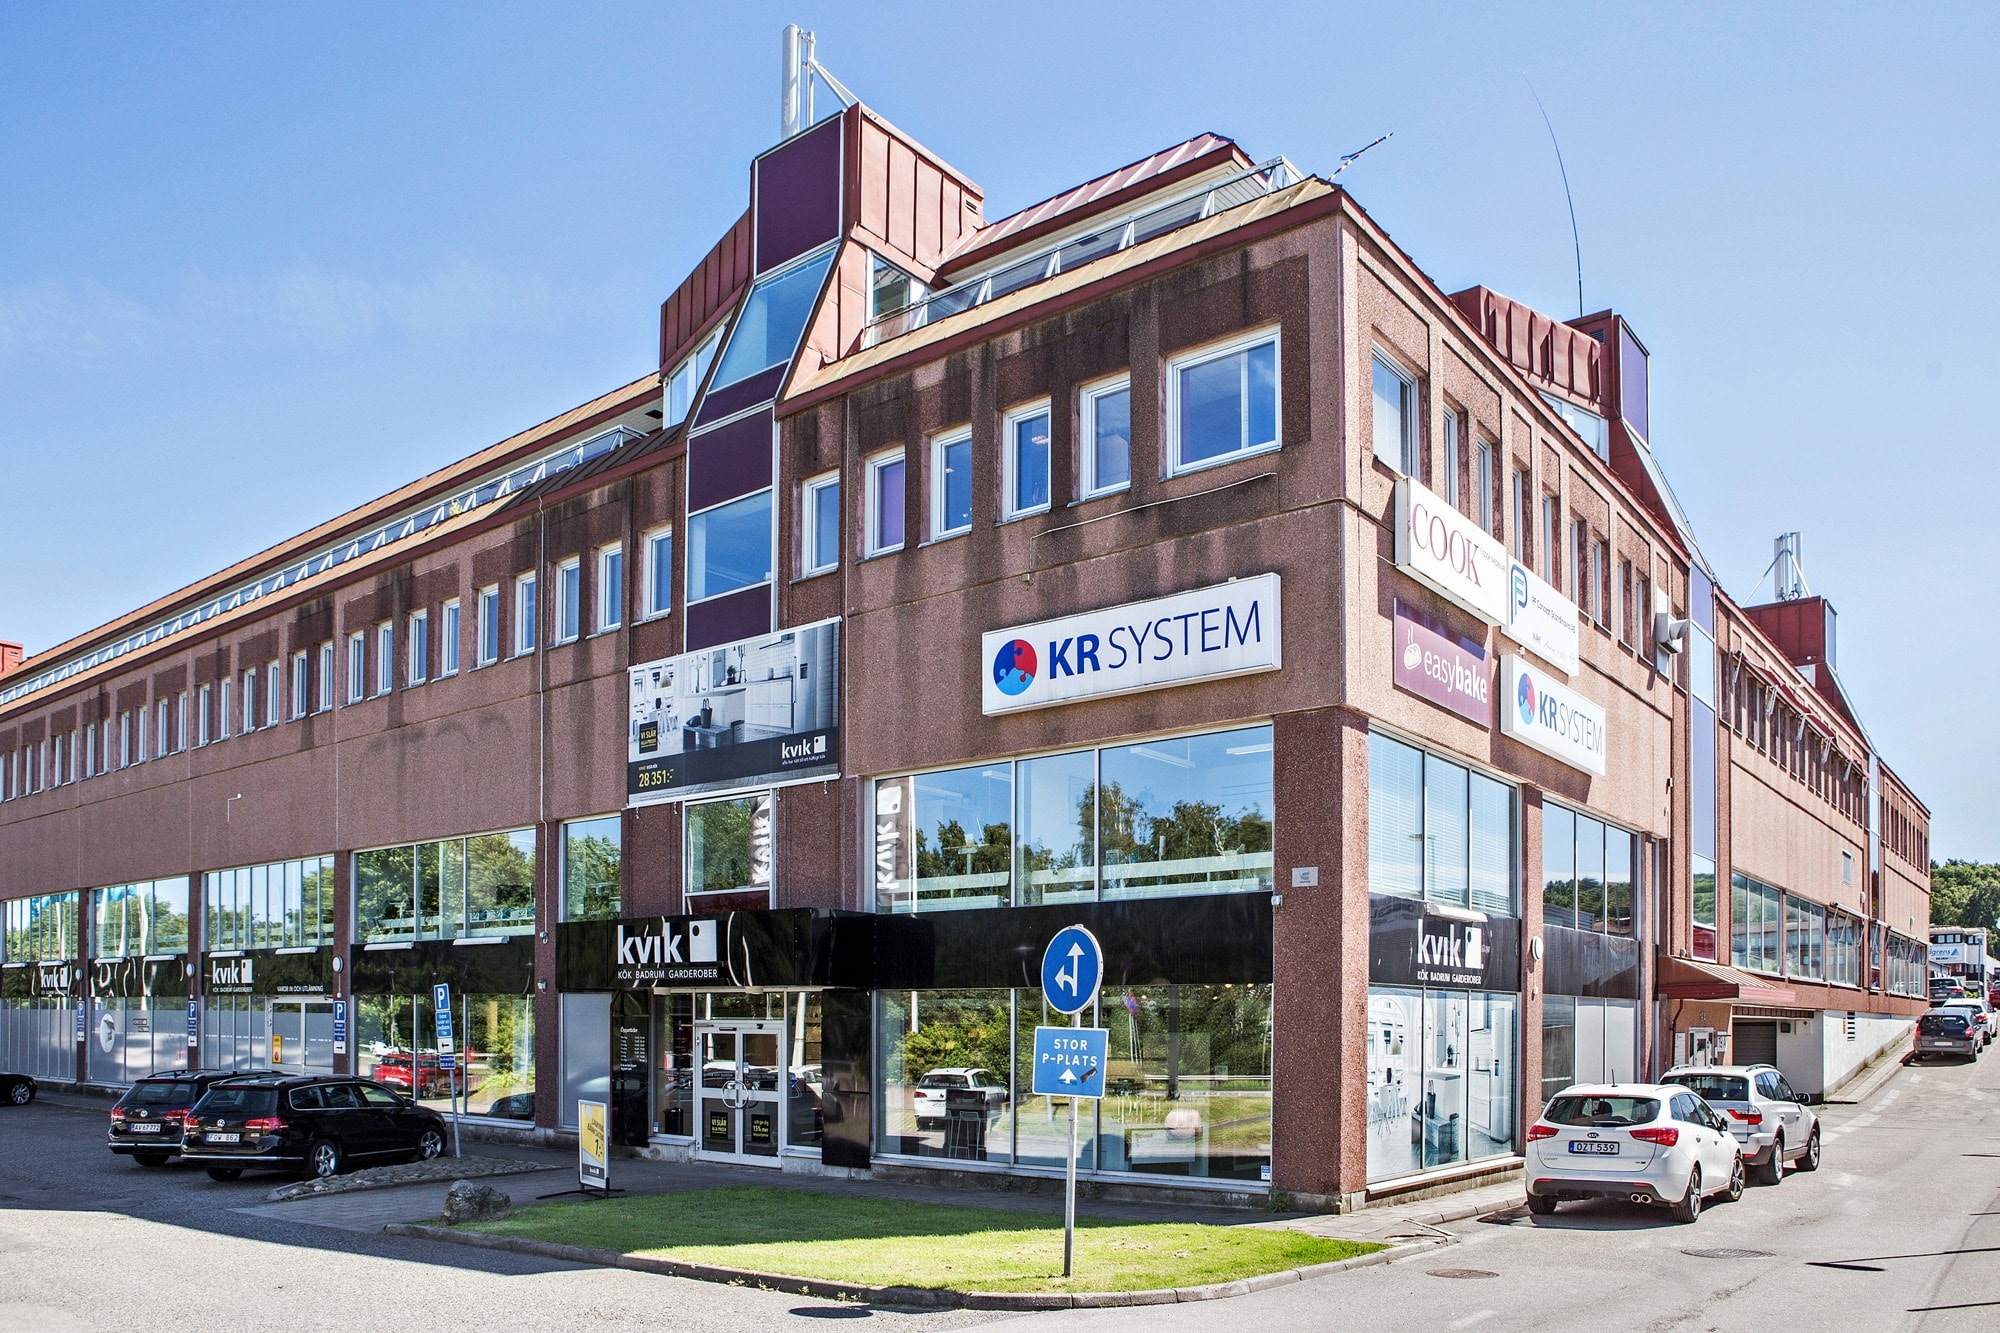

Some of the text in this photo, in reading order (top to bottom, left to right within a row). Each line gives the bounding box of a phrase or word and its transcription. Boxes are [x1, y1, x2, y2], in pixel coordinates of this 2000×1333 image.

[1412, 503, 1481, 587] COOK
[1108, 600, 1261, 669] SYSTEM
[1424, 650, 1487, 704] easybake
[1560, 702, 1602, 756] SYSTEM
[781, 738, 811, 759] kvik
[639, 772, 650, 788] 28
[617, 922, 683, 964] kvik
[1417, 918, 1462, 967] kvik
[40, 966, 58, 988] kvik
[212, 960, 239, 984] kvik
[618, 969, 718, 980] KÖK BADRUM GARDEROBER
[1417, 968, 1482, 984] KÖK BADRUM GARDEROBER
[438, 988, 445, 1008] P
[190, 1006, 195, 1017] P
[336, 1003, 342, 1019] P
[1054, 1038, 1088, 1051] STOR
[1042, 1053, 1098, 1067] P-PLATS
[1576, 1144, 1594, 1152] OZT
